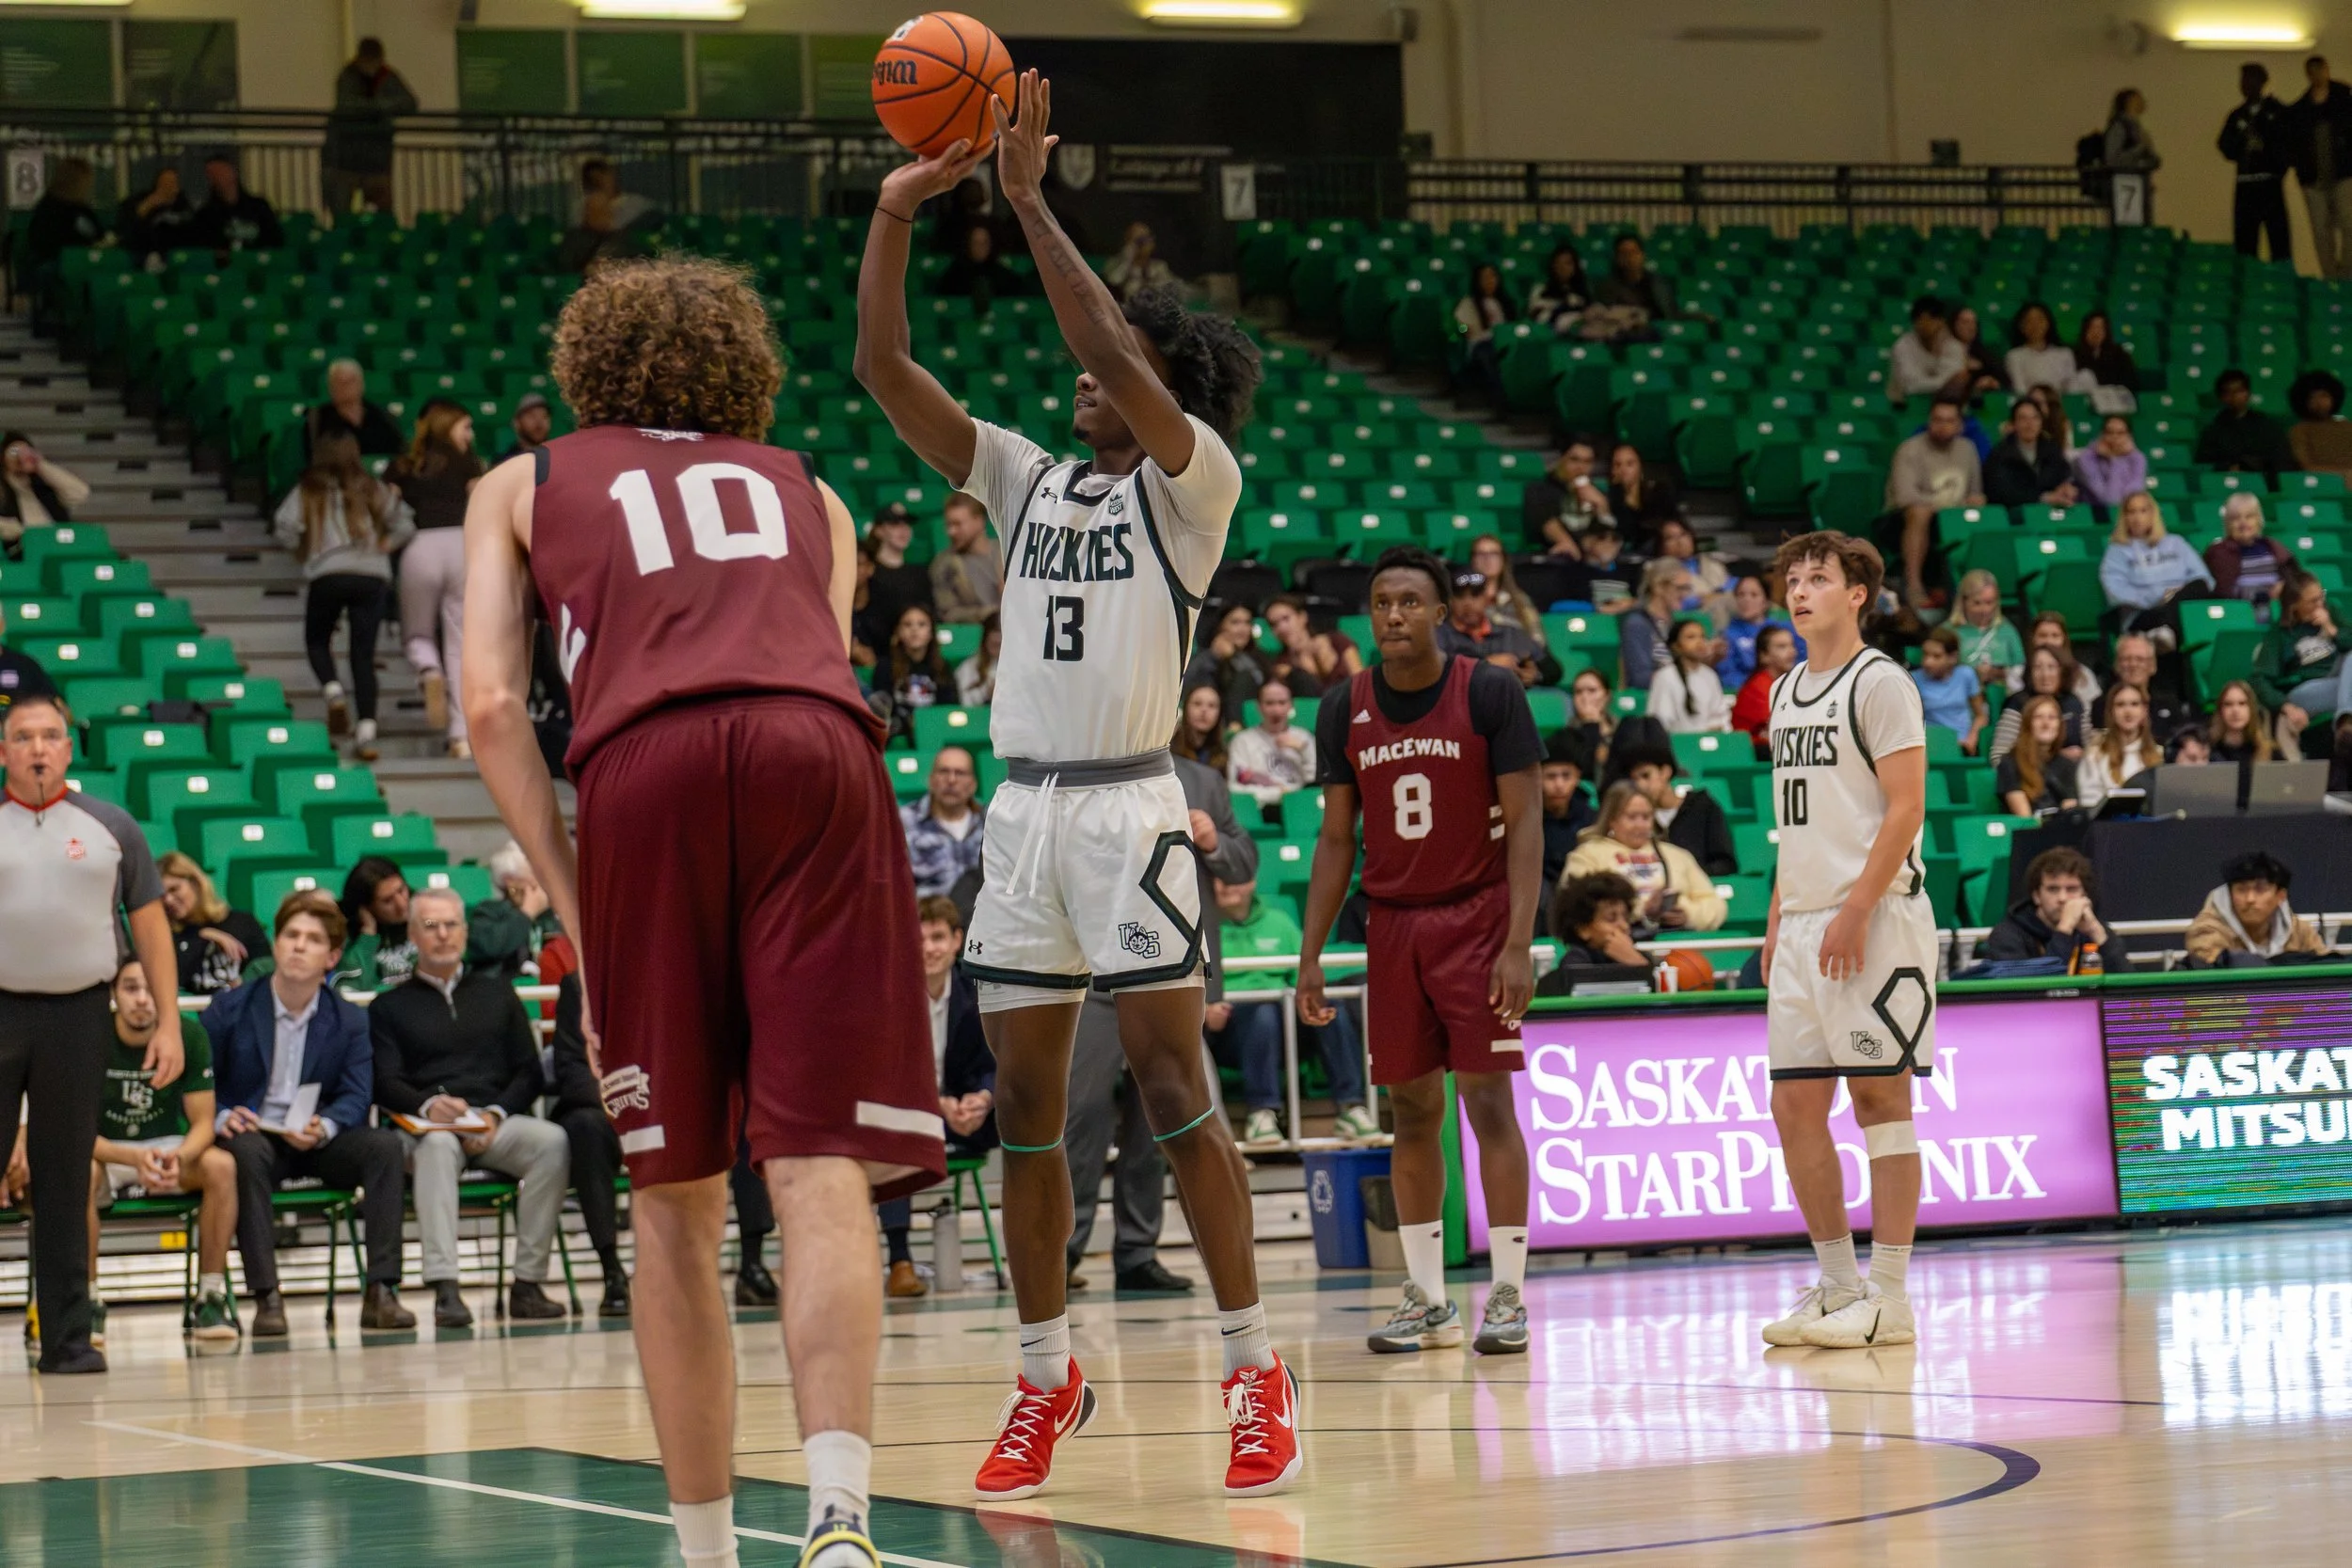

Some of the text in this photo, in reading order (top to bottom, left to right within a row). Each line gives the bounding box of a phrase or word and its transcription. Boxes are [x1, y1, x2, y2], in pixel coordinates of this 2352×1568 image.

[1232, 178, 1247, 207] 7
[2121, 183, 2137, 212] 7
[608, 462, 789, 577] 10
[1019, 521, 1135, 583] HUSKIES
[1042, 594, 1085, 662] 13
[1392, 772, 1434, 841] 8
[1782, 777, 1809, 827] 10
[1529, 1043, 1959, 1132] SASKATN
